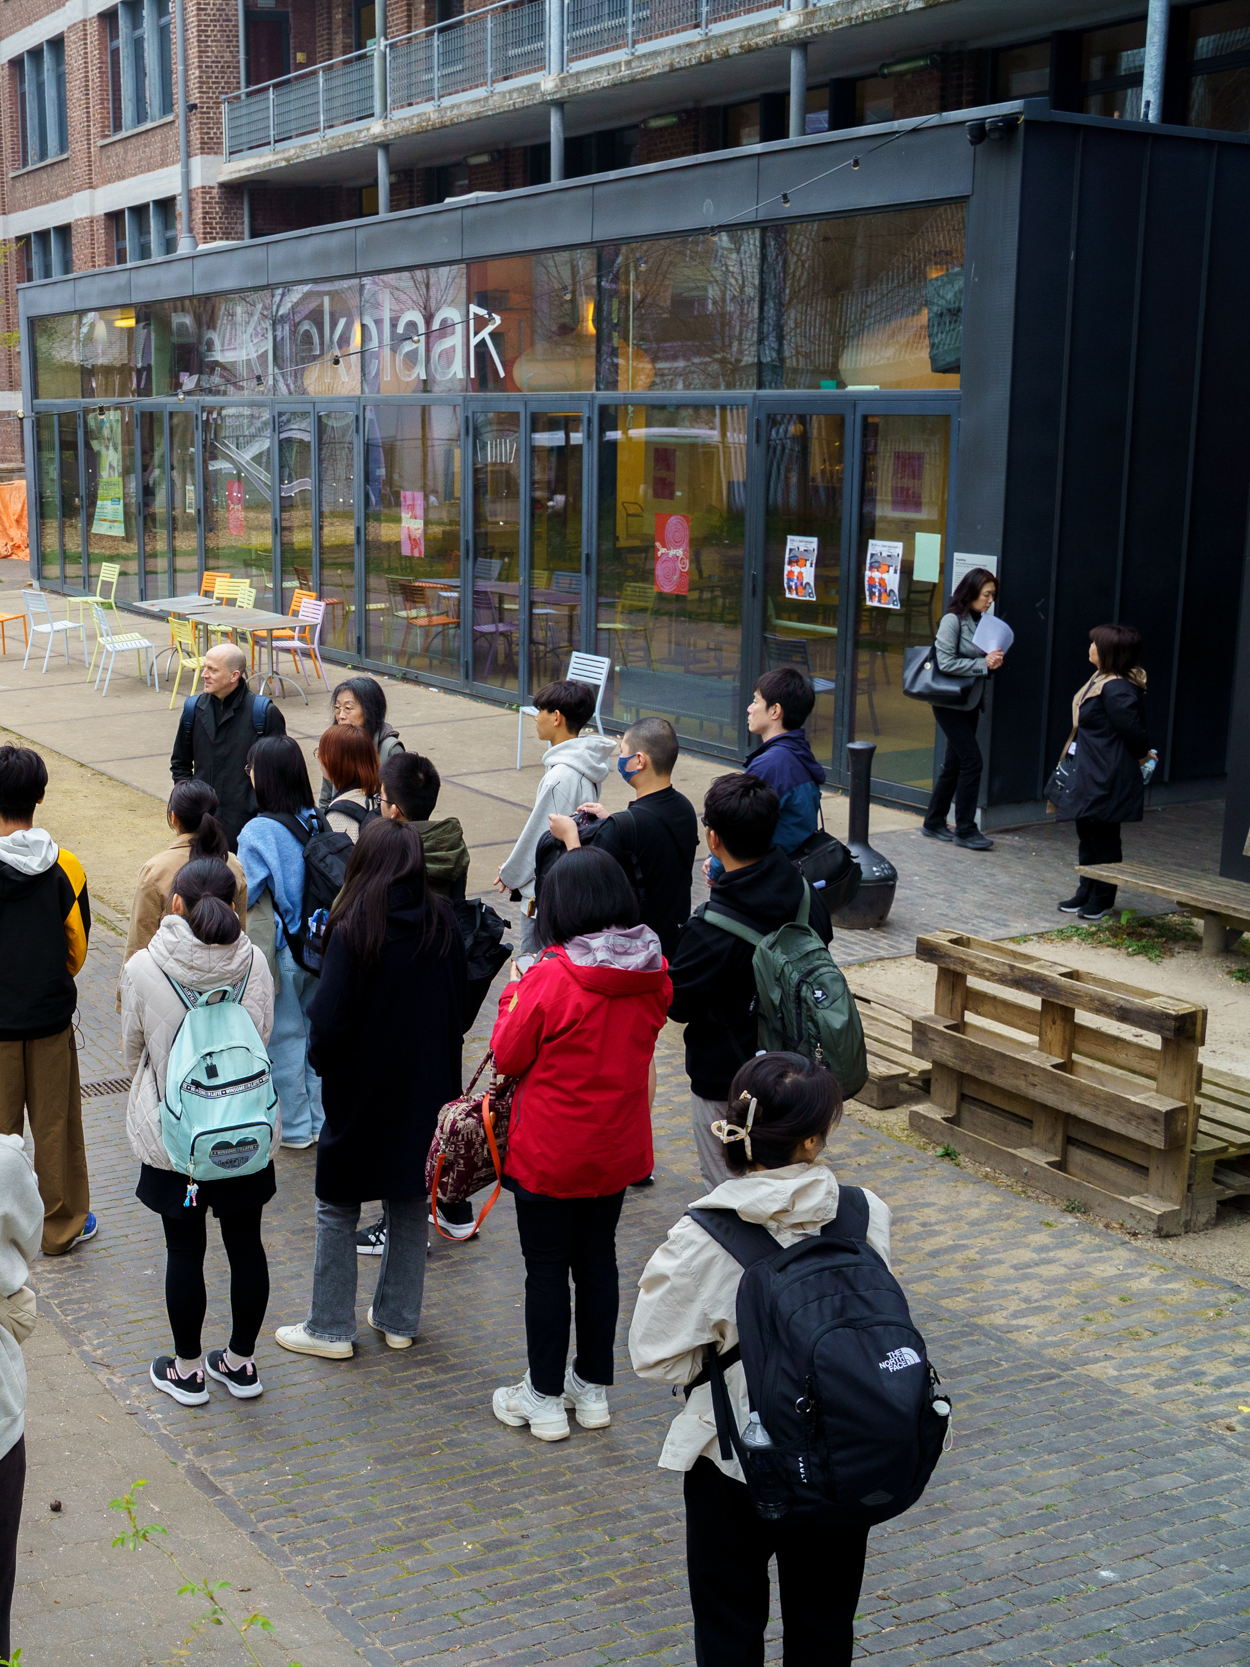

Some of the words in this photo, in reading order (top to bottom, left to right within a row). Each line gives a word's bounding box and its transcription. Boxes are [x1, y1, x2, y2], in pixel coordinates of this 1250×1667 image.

[886, 1348, 903, 1359] THE
[878, 1356, 906, 1370] NORTH
[889, 1360, 908, 1373] FACE
[798, 1456, 808, 1484] VAULT
